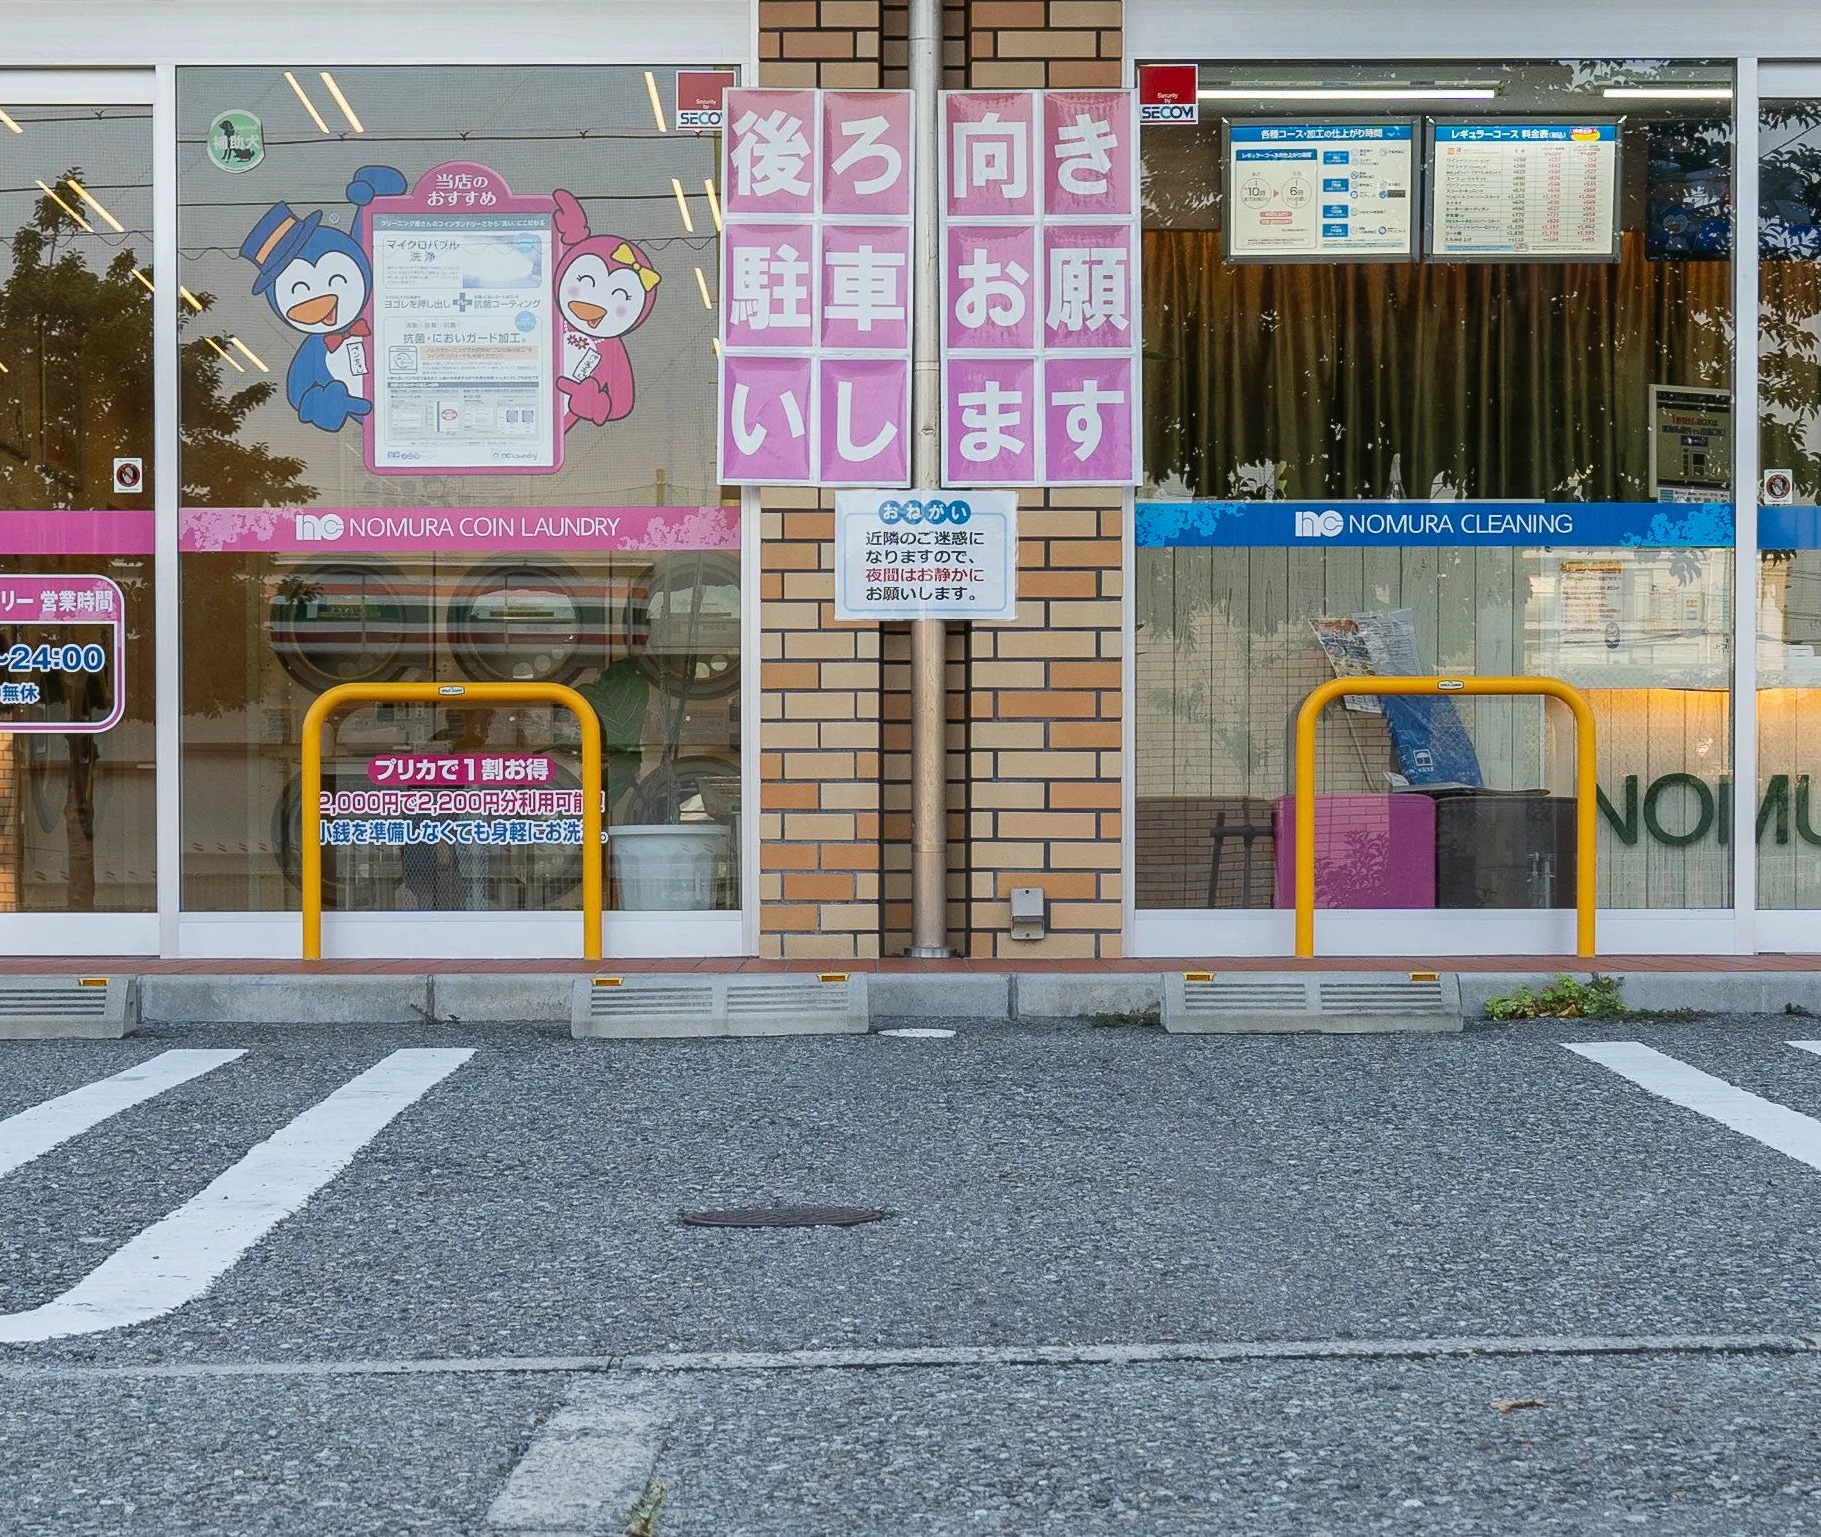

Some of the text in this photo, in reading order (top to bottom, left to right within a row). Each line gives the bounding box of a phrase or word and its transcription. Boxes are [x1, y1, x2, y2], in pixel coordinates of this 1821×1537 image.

[680, 112, 723, 125] SECO
[1142, 106, 1194, 119] SECOM
[1451, 130, 1519, 140] レギュラーコース
[436, 174, 489, 190] 当店の
[427, 191, 497, 207] おすすめ
[386, 239, 460, 251] マイクロバブル
[881, 503, 968, 521] おねがい
[350, 518, 454, 538] NOMURA
[459, 518, 514, 538] COIN
[521, 517, 620, 538] LAUNDRY
[1348, 513, 1453, 535] NOMURA
[1461, 513, 1573, 535] CLEANING
[865, 531, 985, 546] 近隣のご迷惑に
[865, 550, 975, 564] なりますので、
[865, 568, 985, 583] 夜間はお静かに
[865, 586, 976, 601] お願いします。
[40, 591, 113, 612] 営業時間
[375, 759, 549, 781] プリカで1割お得
